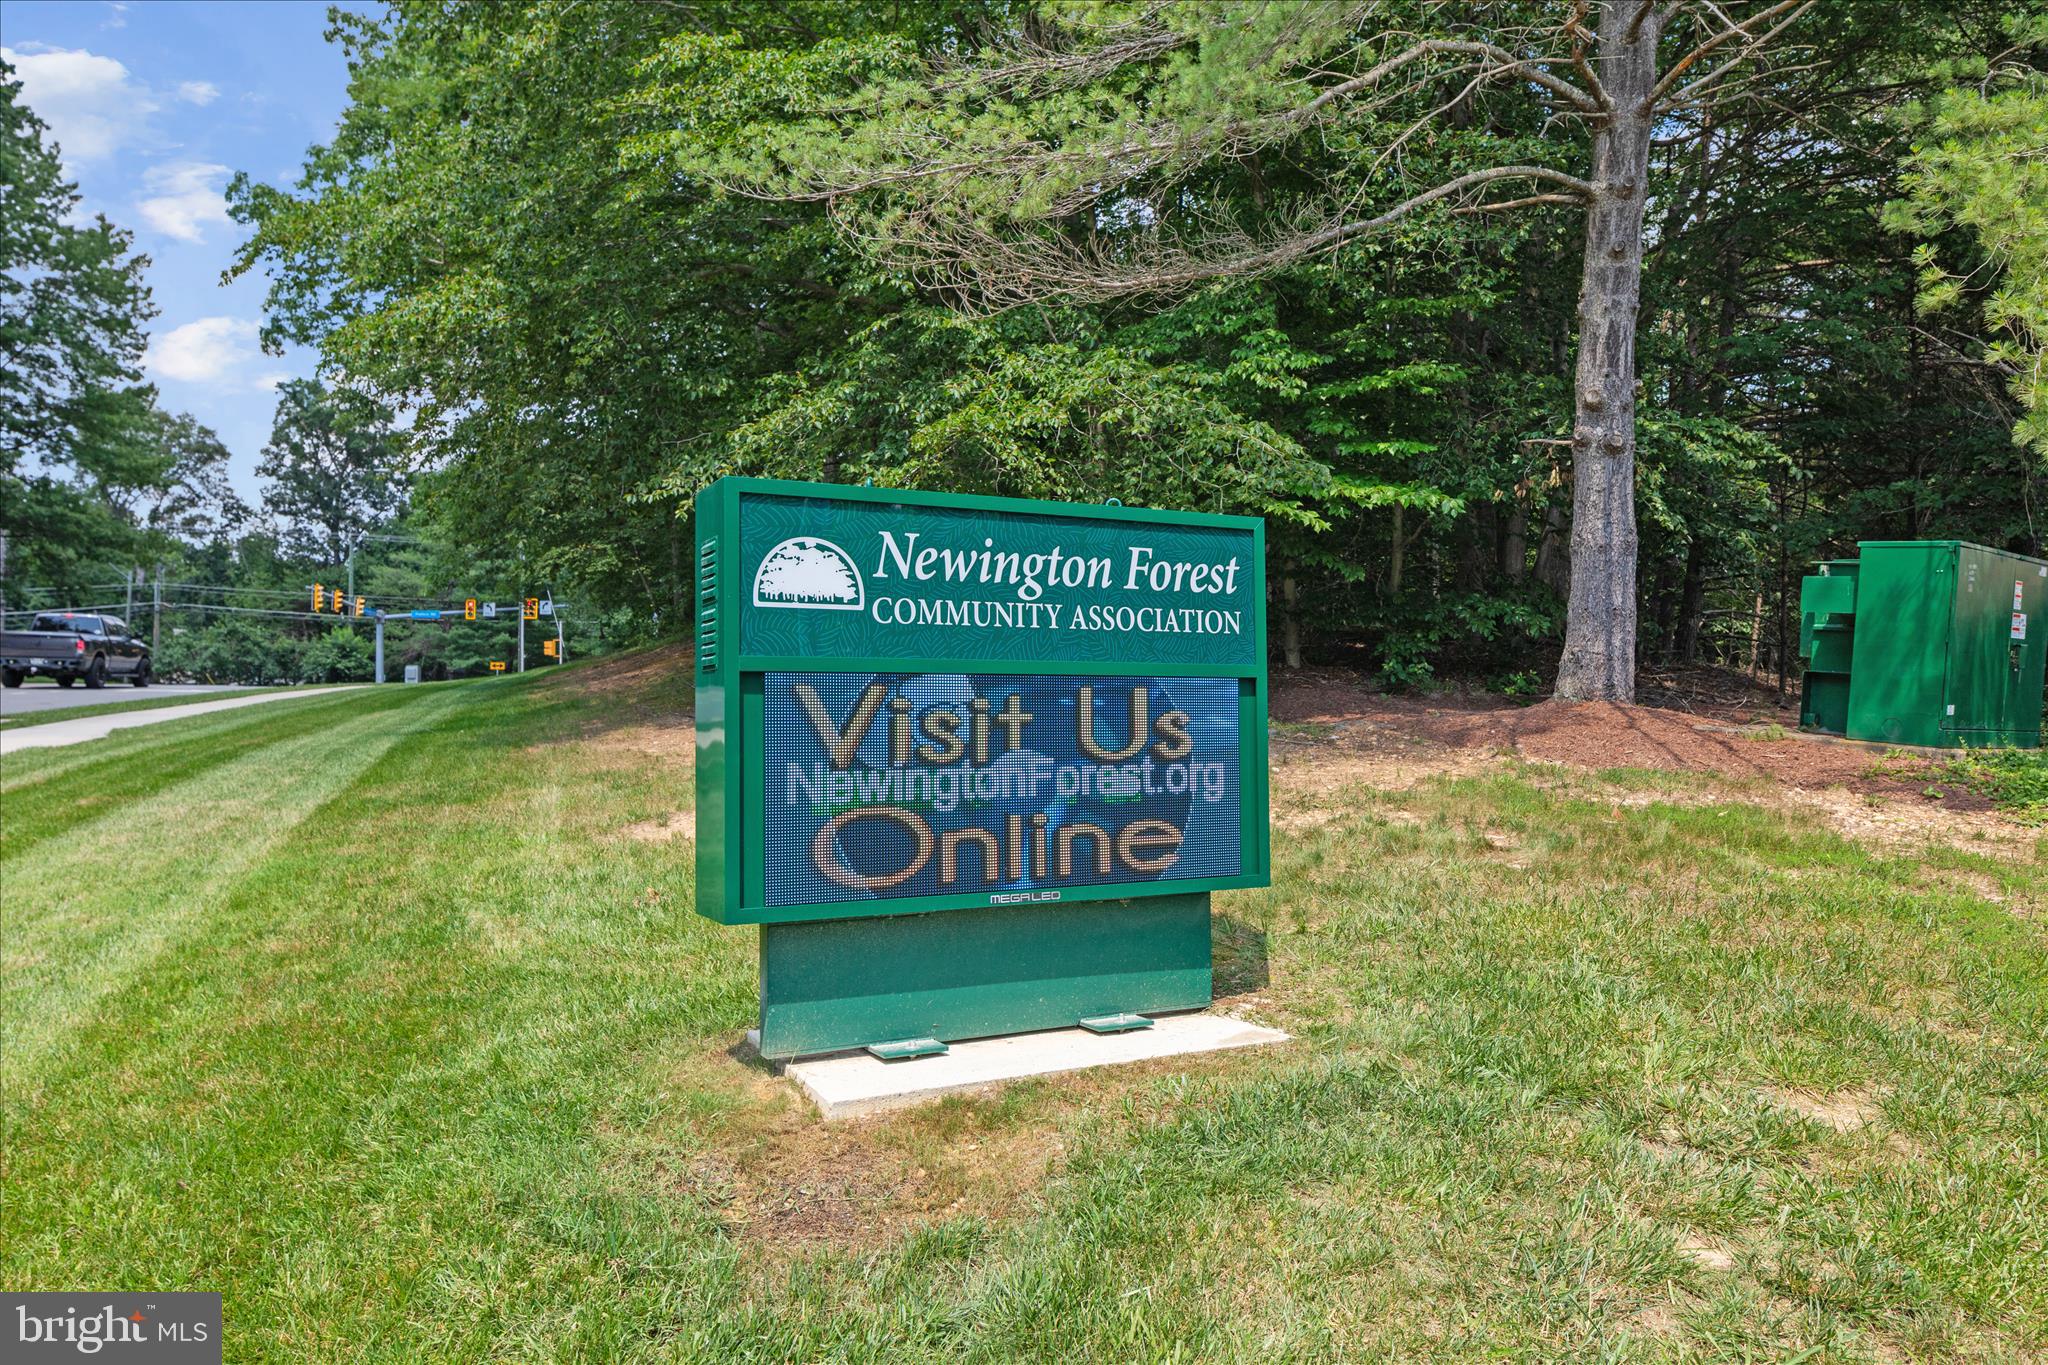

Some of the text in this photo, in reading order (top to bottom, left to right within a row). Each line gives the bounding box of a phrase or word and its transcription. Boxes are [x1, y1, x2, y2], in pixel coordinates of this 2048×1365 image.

[872, 530, 1241, 601] Newington Forest
[871, 597, 1242, 635] COMMUNITY ASSOCIATION
[792, 683, 1194, 768] Visit Us
[786, 755, 1226, 812] NewingtonForest.org
[812, 805, 1185, 890] Online
